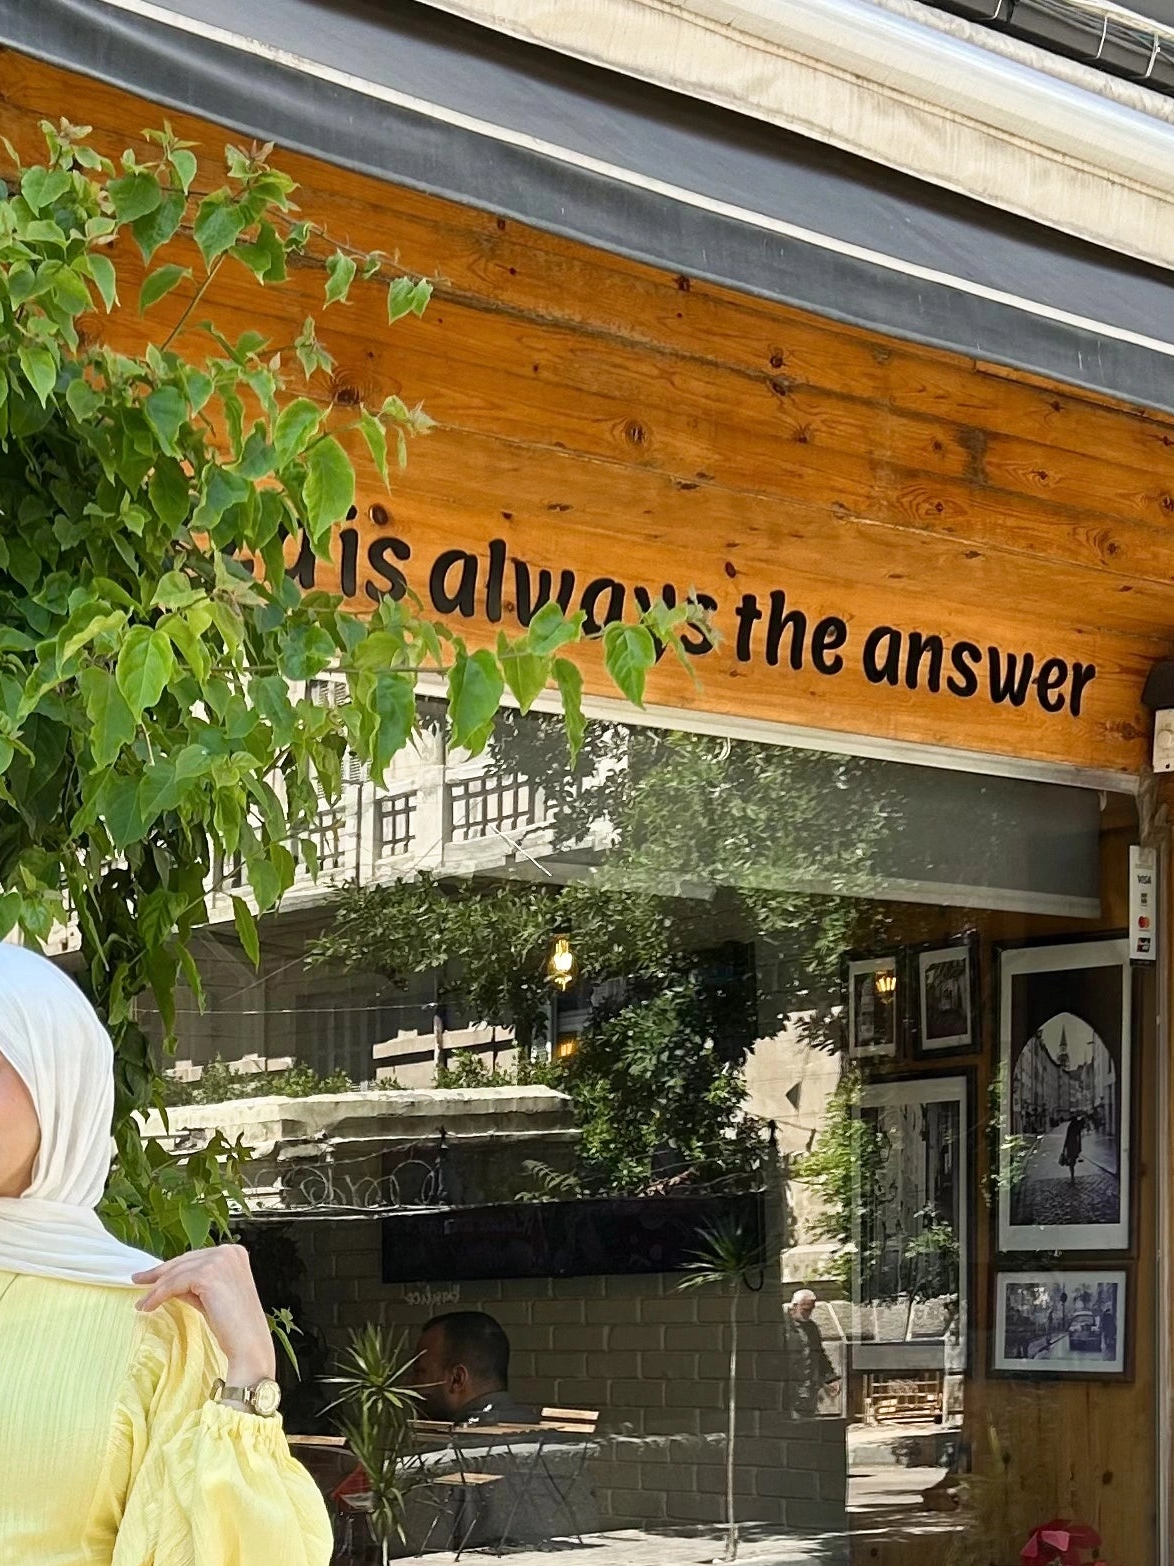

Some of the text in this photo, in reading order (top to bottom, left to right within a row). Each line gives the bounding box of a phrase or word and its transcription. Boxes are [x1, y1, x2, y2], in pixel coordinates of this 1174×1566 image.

[339, 504, 412, 603] is
[429, 538, 719, 665] always
[735, 589, 847, 677] the
[862, 626, 1097, 718] answer
[1137, 874, 1152, 885] VISA
